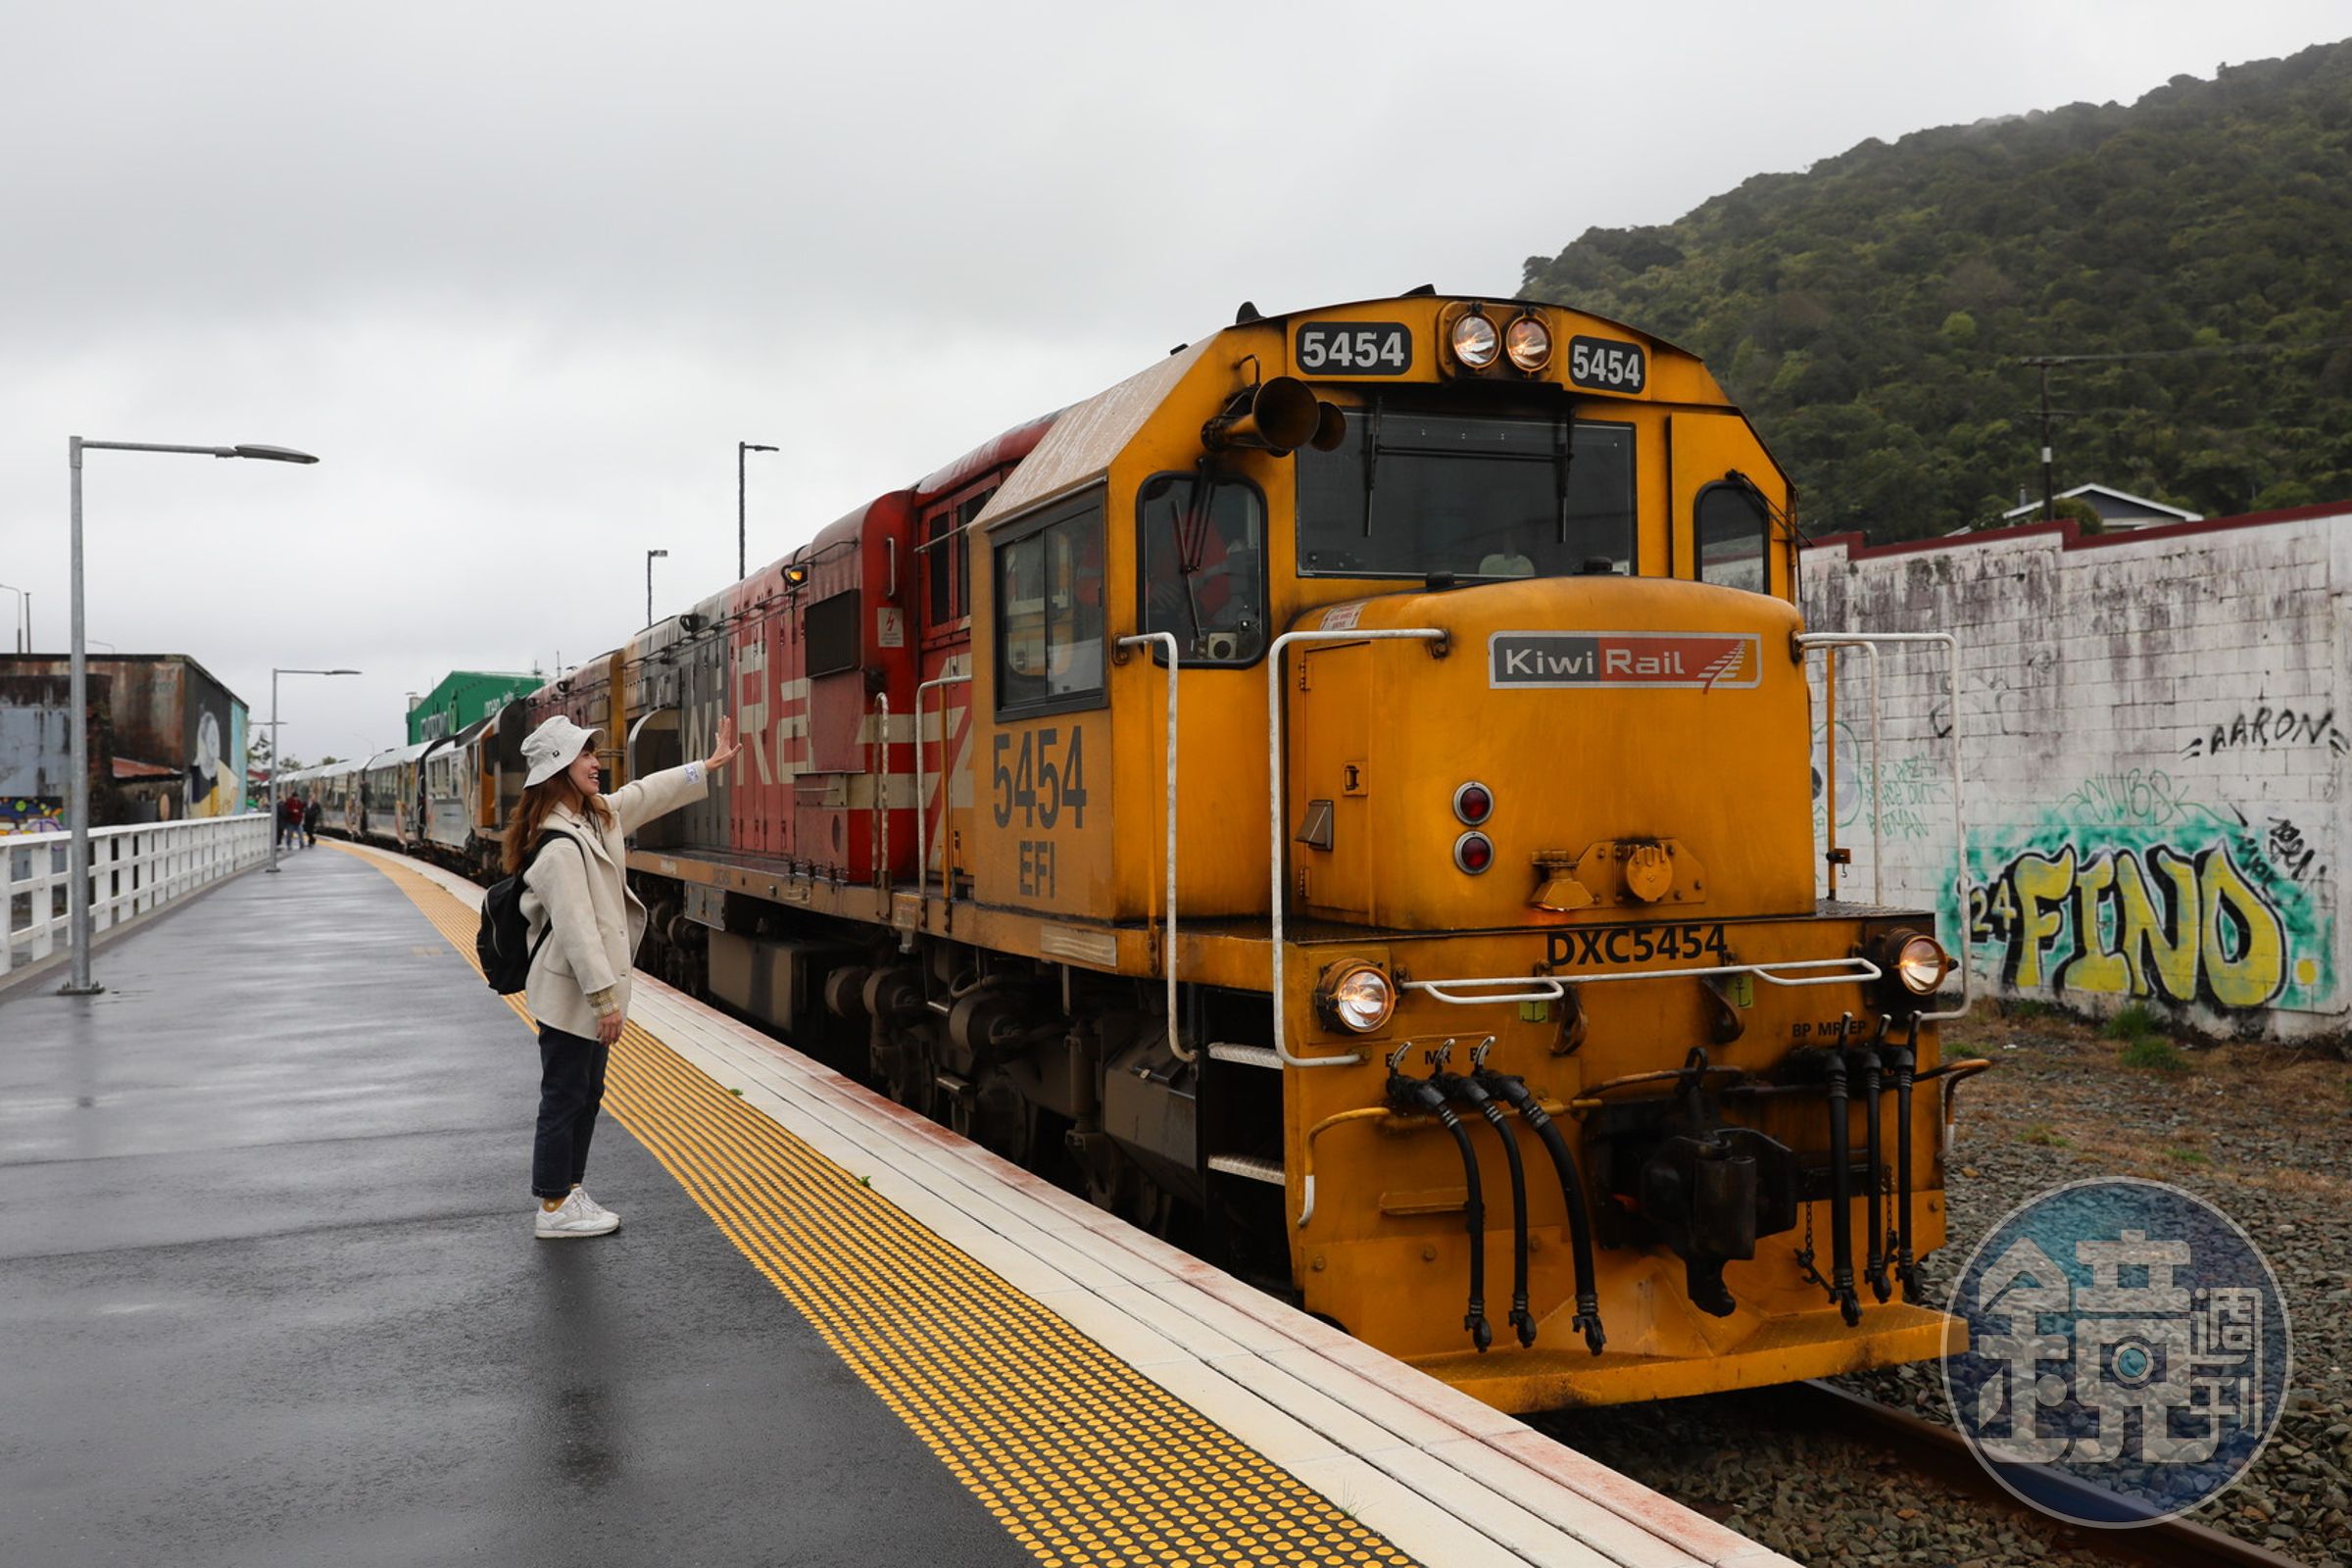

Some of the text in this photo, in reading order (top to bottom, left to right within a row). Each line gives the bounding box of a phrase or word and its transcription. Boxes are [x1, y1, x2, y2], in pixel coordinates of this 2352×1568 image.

[1302, 331, 1404, 368] 5454
[1572, 344, 1641, 387] 5454
[2210, 707, 2332, 756] AARON
[993, 726, 1087, 829] 5454
[1019, 841, 1054, 899] EFI
[1546, 924, 1728, 966] DXC5454
[1792, 1023, 1811, 1037] BP
